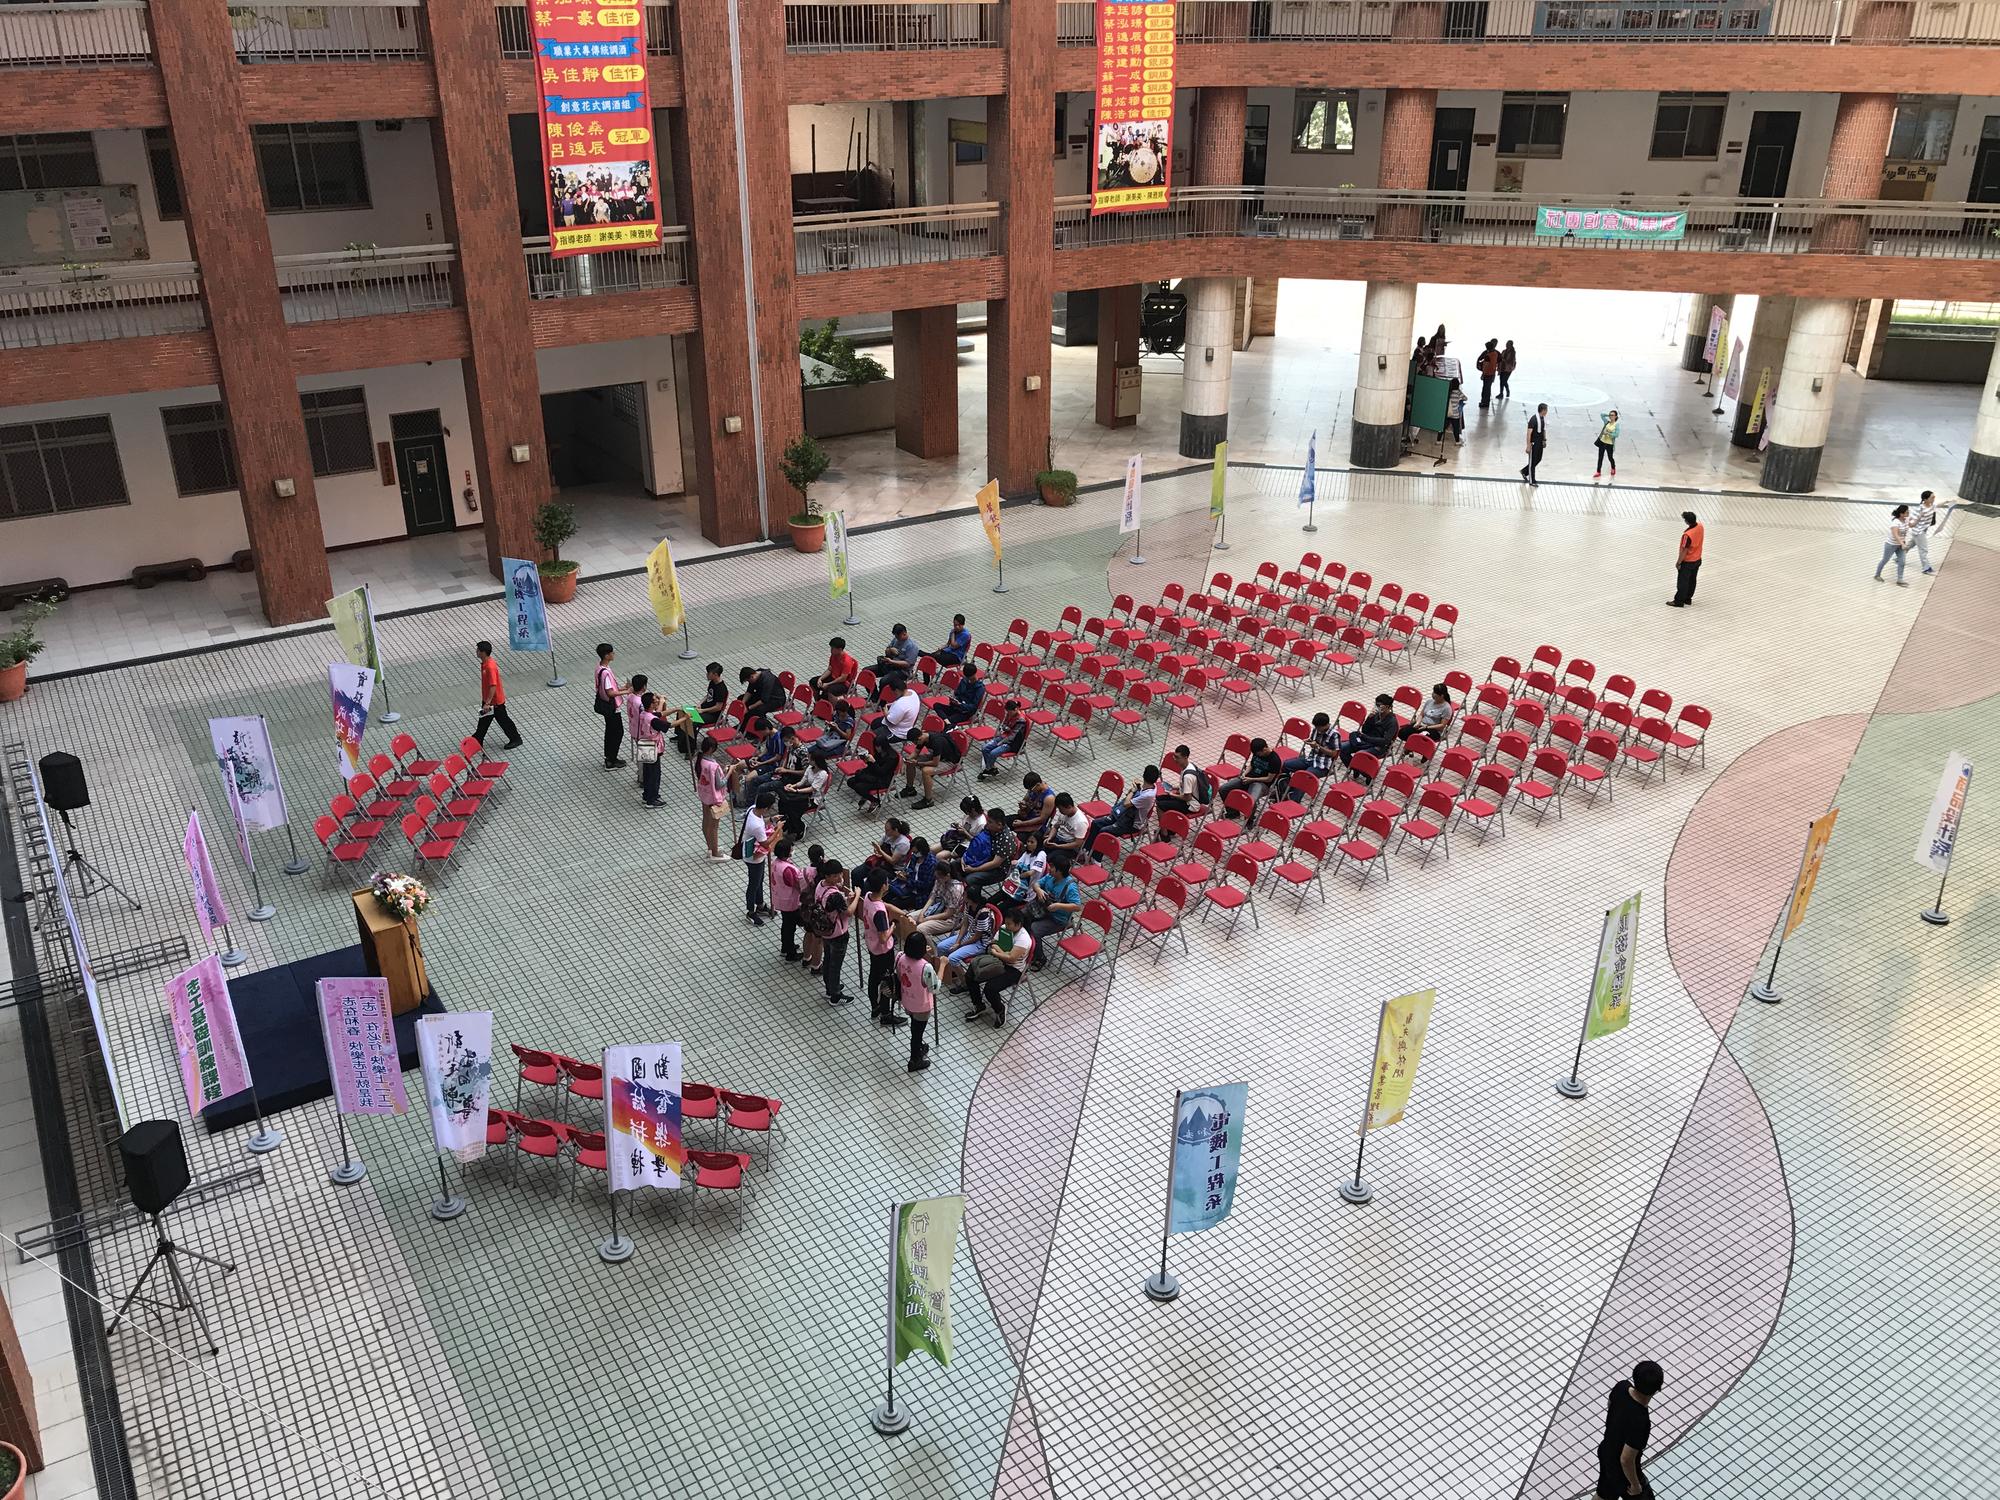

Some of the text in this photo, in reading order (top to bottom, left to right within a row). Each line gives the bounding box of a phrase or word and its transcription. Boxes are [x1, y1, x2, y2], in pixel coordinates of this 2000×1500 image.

[535, 10, 635, 27] 蔡一豪 佳作
[553, 44, 628, 57] 職業大專傳統調酒
[543, 66, 640, 84] 吳佳靜 佳作
[560, 99, 631, 113] 創意花式調酒組
[614, 129, 645, 144] 冠軍
[550, 140, 607, 159] 呂逸辰
[512, 576, 530, 639] 電機工程系
[185, 976, 224, 1102] 志工基礎訓練課程
